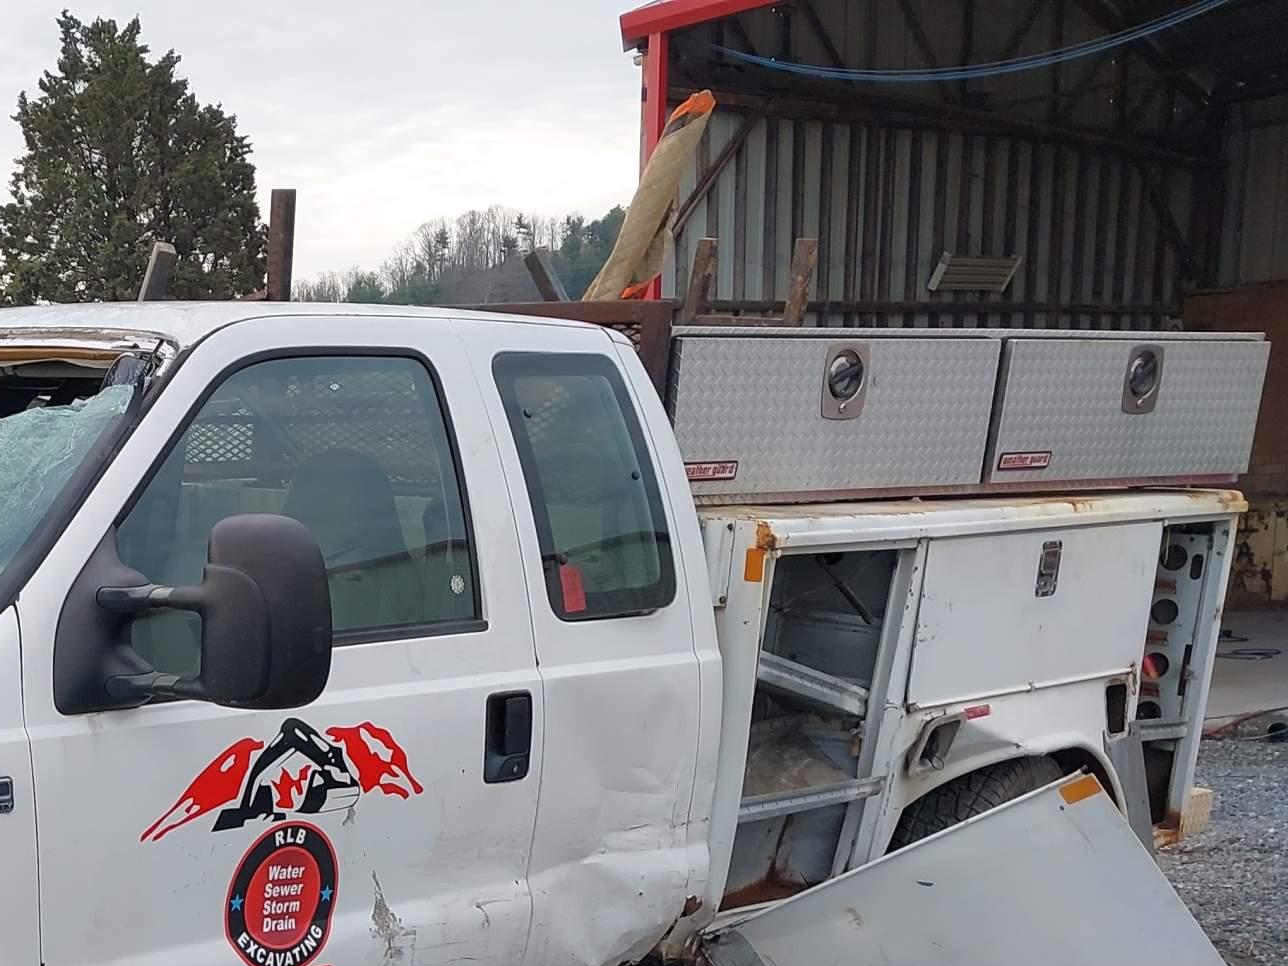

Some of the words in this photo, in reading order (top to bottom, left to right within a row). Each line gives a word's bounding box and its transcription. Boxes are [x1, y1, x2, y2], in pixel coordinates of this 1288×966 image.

[685, 465, 712, 476] eather
[712, 464, 734, 476] guard
[274, 827, 307, 847] RLB
[268, 865, 306, 881] Water
[264, 883, 304, 899] Sewer
[263, 900, 300, 915] Storm
[263, 916, 297, 933] Drain
